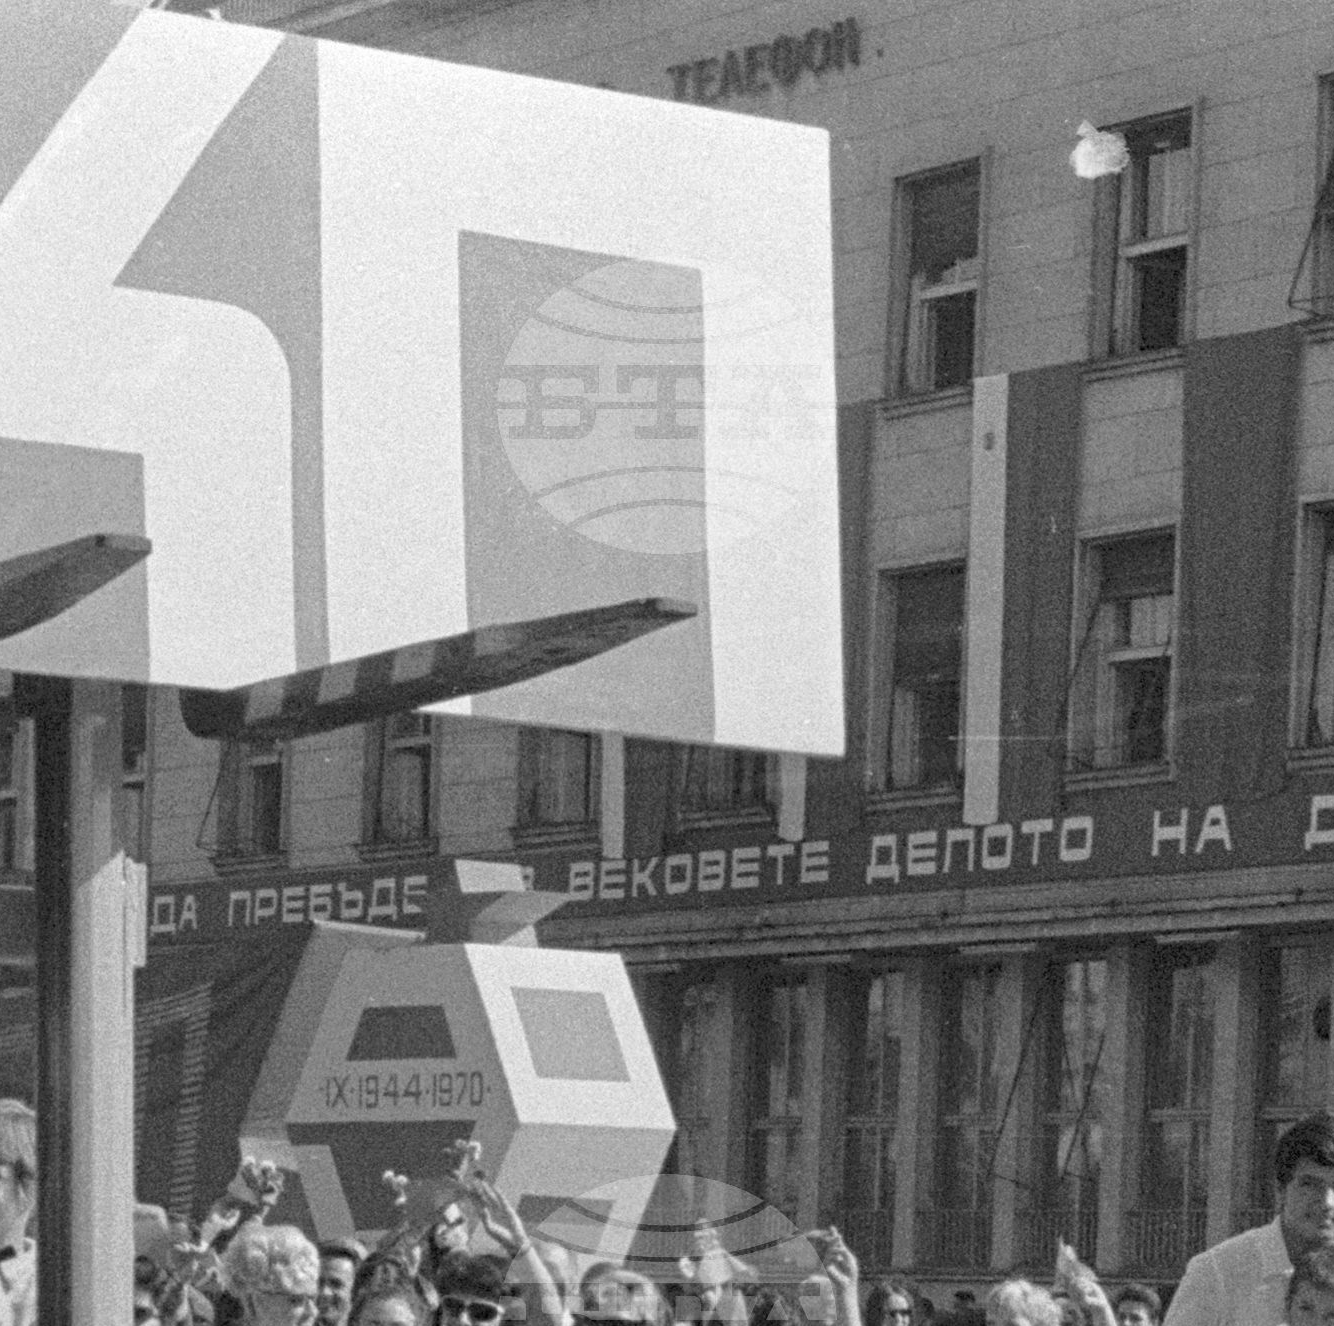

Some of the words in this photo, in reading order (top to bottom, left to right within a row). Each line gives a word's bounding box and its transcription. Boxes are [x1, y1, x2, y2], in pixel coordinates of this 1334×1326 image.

[149, 894, 198, 936] ДА
[228, 875, 428, 927] ПРЕБЪДЕ
[569, 841, 830, 900] ВЕКОВЕТЕ
[866, 816, 1094, 885] ДЕЛОТО
[1151, 805, 1232, 857] НА
